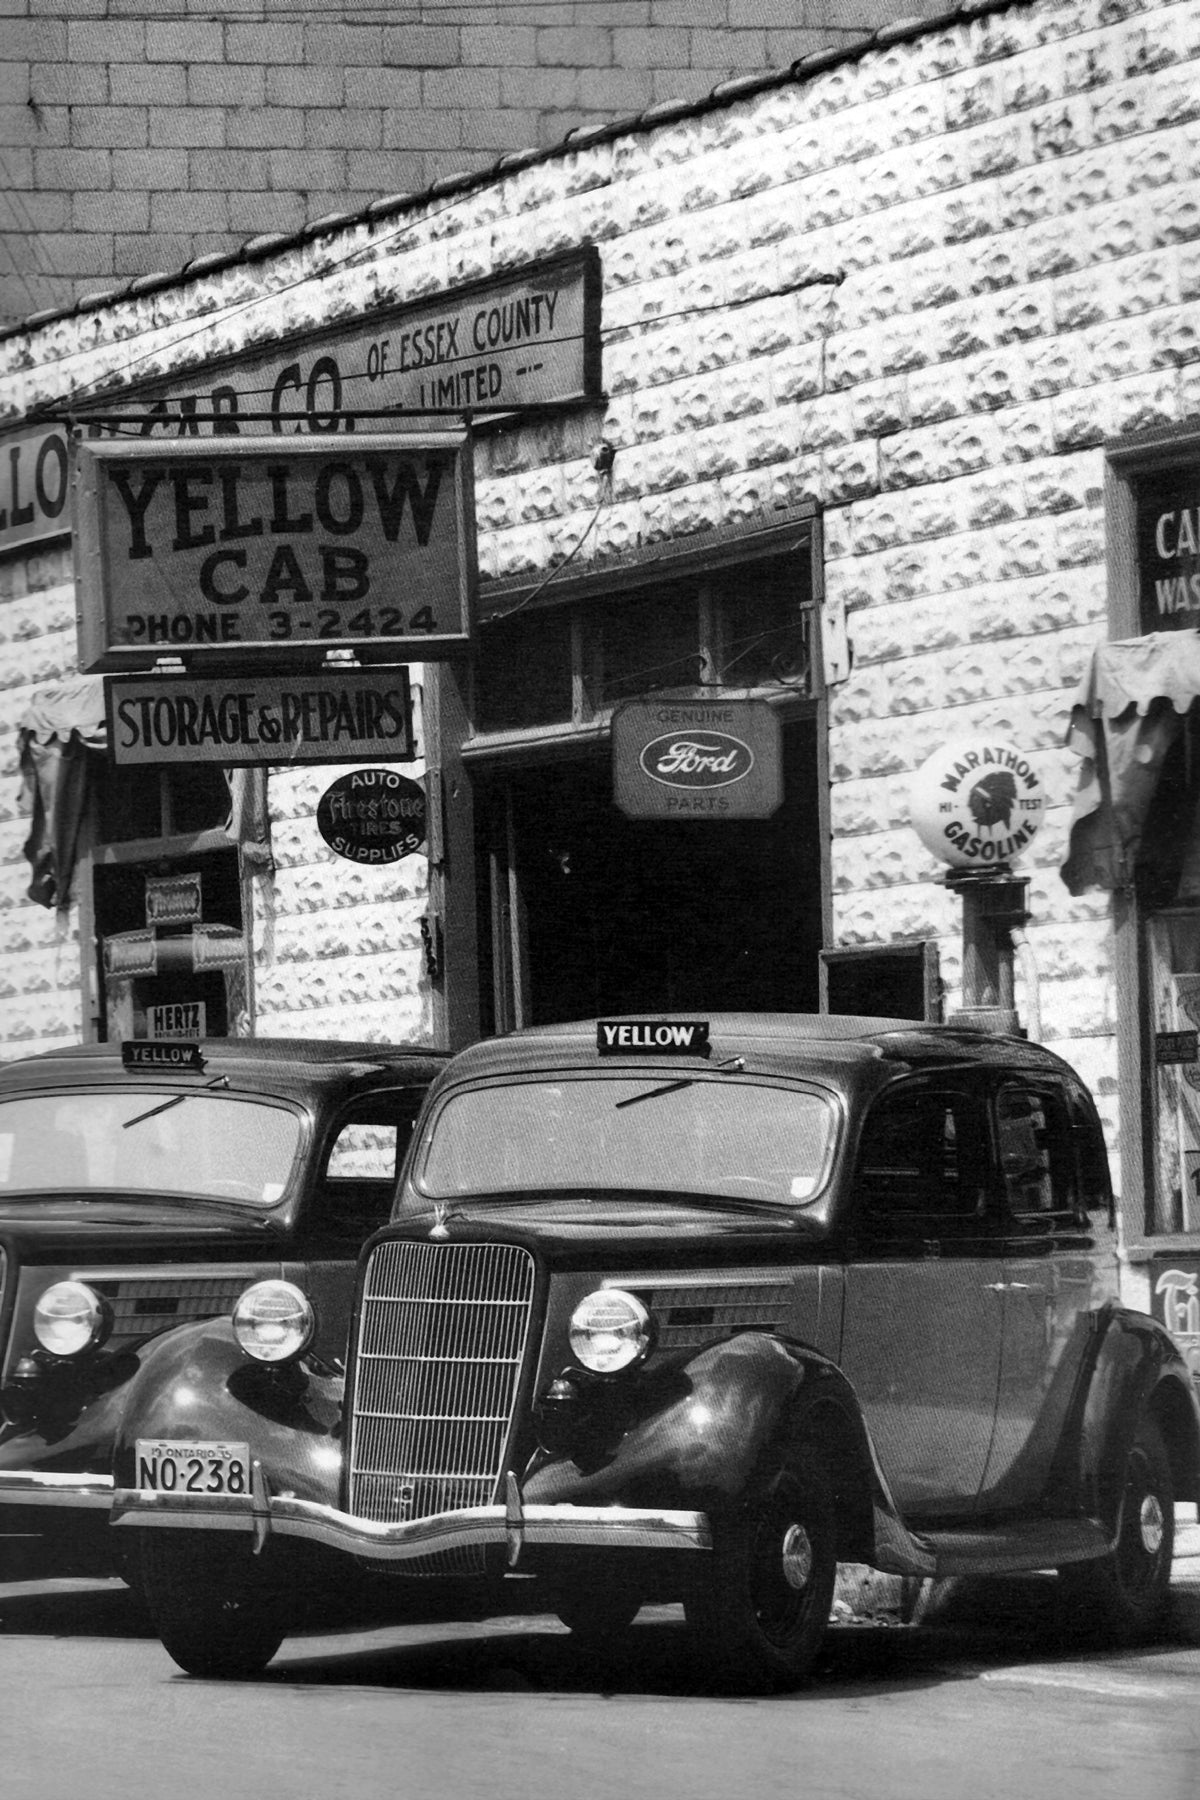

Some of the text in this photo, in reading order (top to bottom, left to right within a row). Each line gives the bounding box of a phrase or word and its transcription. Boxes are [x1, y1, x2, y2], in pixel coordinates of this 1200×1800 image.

[367, 291, 558, 381] OF ESSEX COUNTY
[420, 363, 501, 408] LIMITED
[108, 461, 449, 559] YELLOW
[1156, 507, 1200, 559] CA
[200, 544, 370, 604] CAB
[127, 606, 437, 642] PHONE 3-2424
[657, 710, 734, 722] GENUINE
[657, 742, 738, 774] Ford
[940, 747, 1039, 792] MARATHON
[351, 772, 400, 789] AUTO
[668, 797, 730, 811] PARTS
[1019, 799, 1041, 810] TEST
[350, 821, 402, 836] TIRES
[944, 819, 1038, 861] GASOLINE
[332, 833, 420, 862] SUPPLIES
[154, 1004, 200, 1030] HERTZ
[603, 1025, 694, 1046] YELLOW
[131, 1047, 193, 1062] YELLOW
[166, 1448, 215, 1458] ONTARIO
